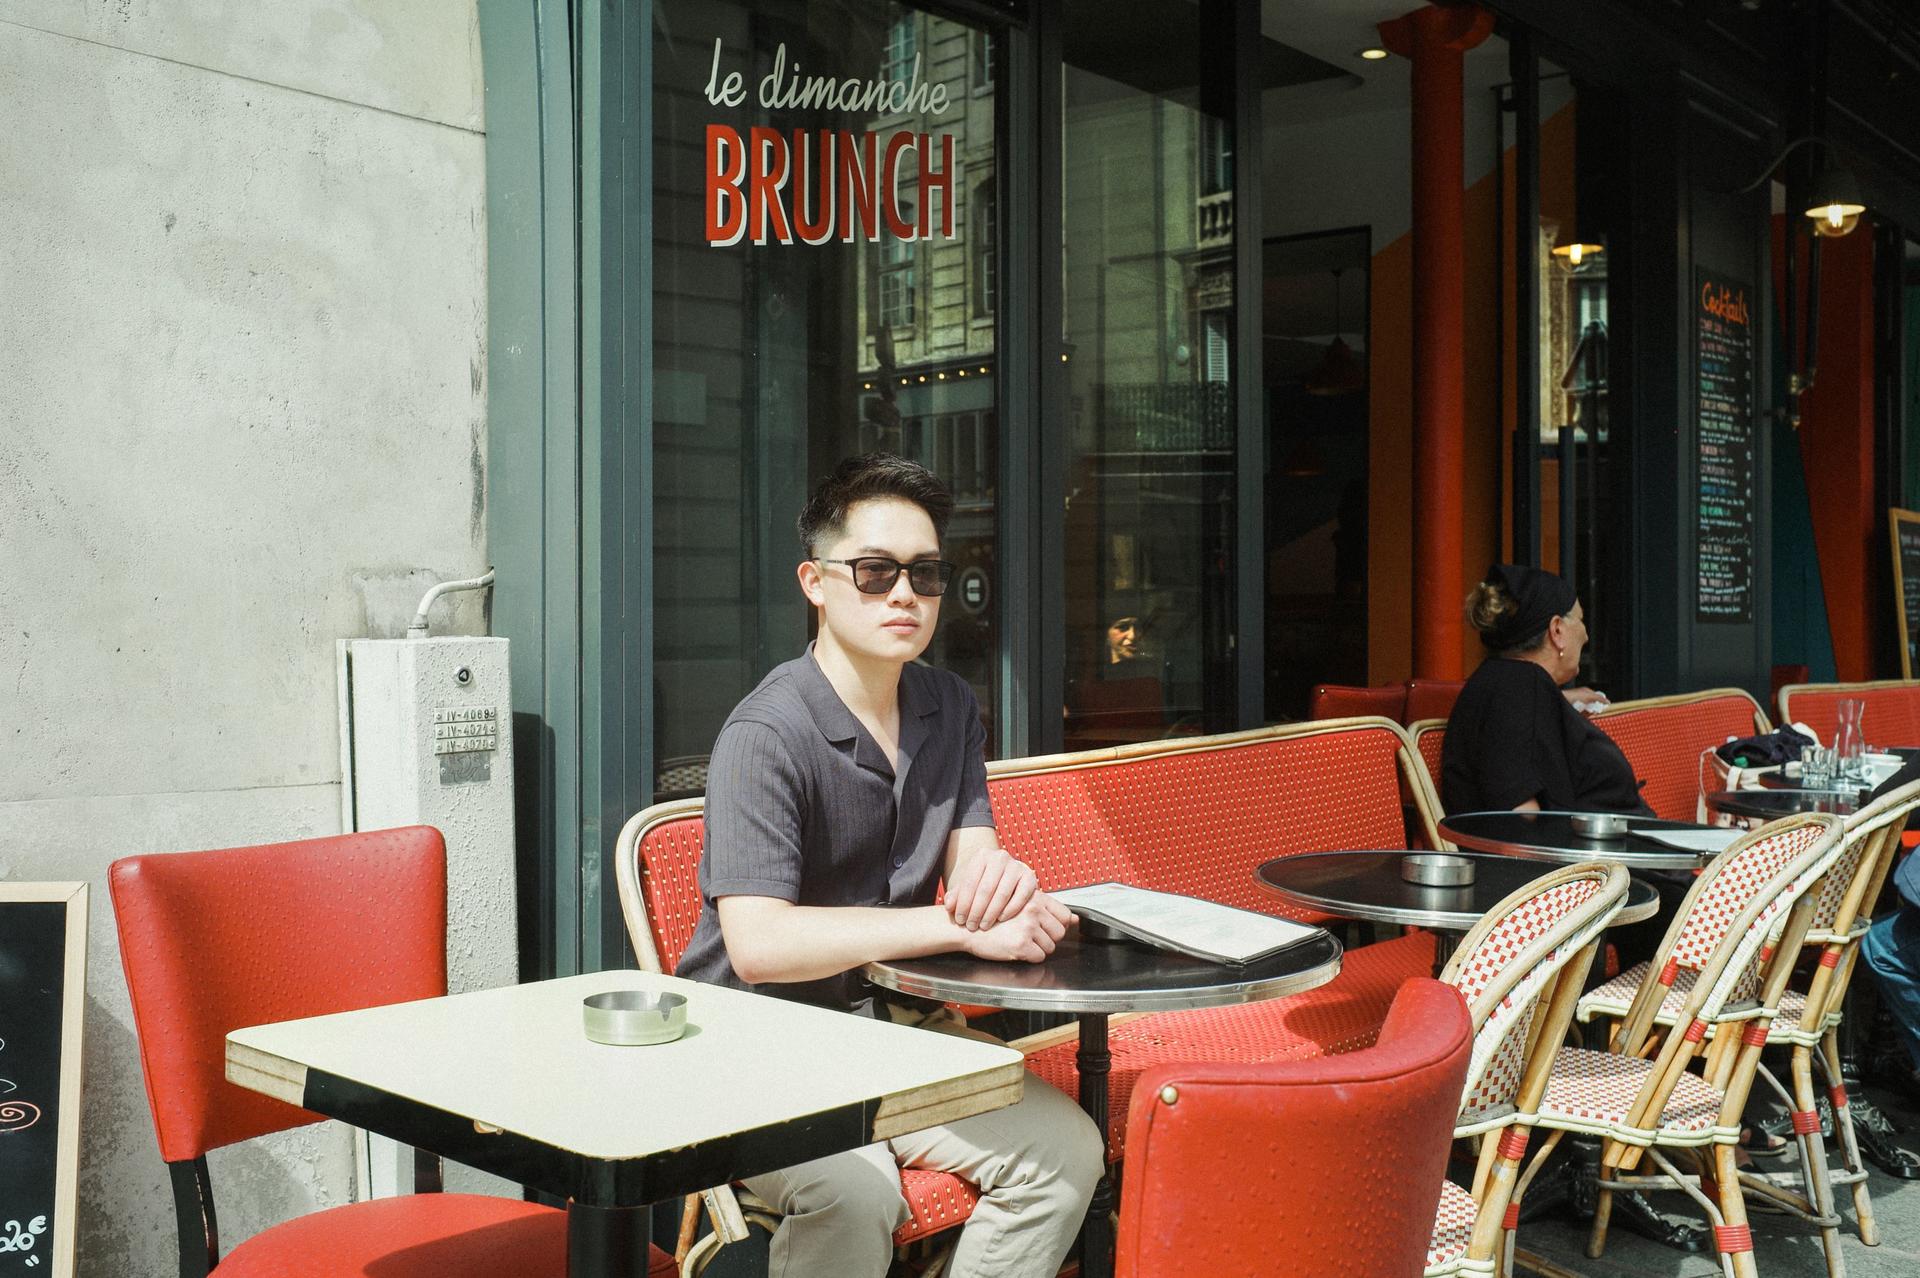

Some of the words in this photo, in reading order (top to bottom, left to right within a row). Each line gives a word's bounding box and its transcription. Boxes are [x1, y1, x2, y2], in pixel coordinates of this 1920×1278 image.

[704, 37, 747, 107] le
[759, 42, 950, 115] dimanche
[706, 124, 956, 247] BRUNCH
[1702, 281, 1749, 325] Cocktails
